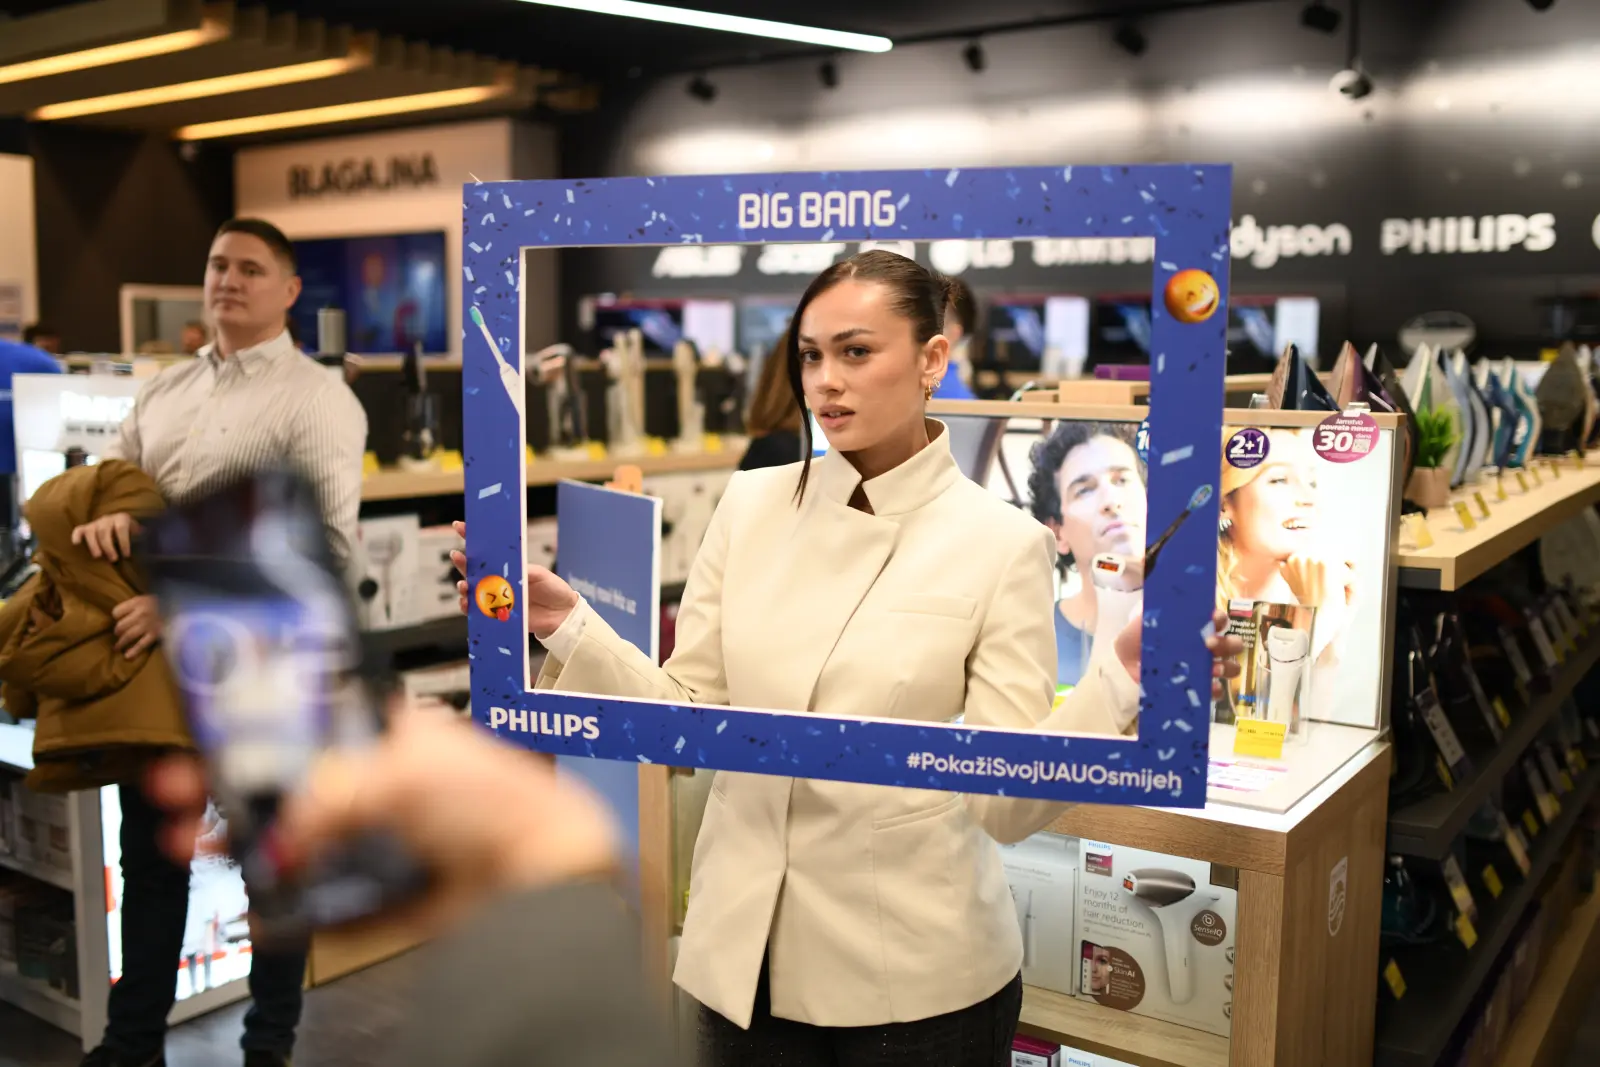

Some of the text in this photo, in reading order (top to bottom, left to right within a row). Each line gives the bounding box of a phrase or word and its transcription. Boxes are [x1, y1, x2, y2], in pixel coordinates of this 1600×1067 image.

[738, 189, 896, 229] BIG BANG
[1230, 213, 1353, 270] dyson
[1380, 212, 1557, 255] PHILIPS
[1230, 435, 1265, 454] 2+1
[1316, 430, 1354, 452] 30
[490, 706, 600, 740] PHILIPS
[906, 751, 1183, 793] #PokažiSvojUAUOsmijeh
[1084, 885, 1119, 901] Enjoy 12
[1084, 899, 1128, 914] months of
[1083, 909, 1100, 918] hair
[1102, 912, 1144, 929] reduction
[1194, 924, 1223, 937] SenseIQ
[1068, 1057, 1091, 1067] PHILIPS
